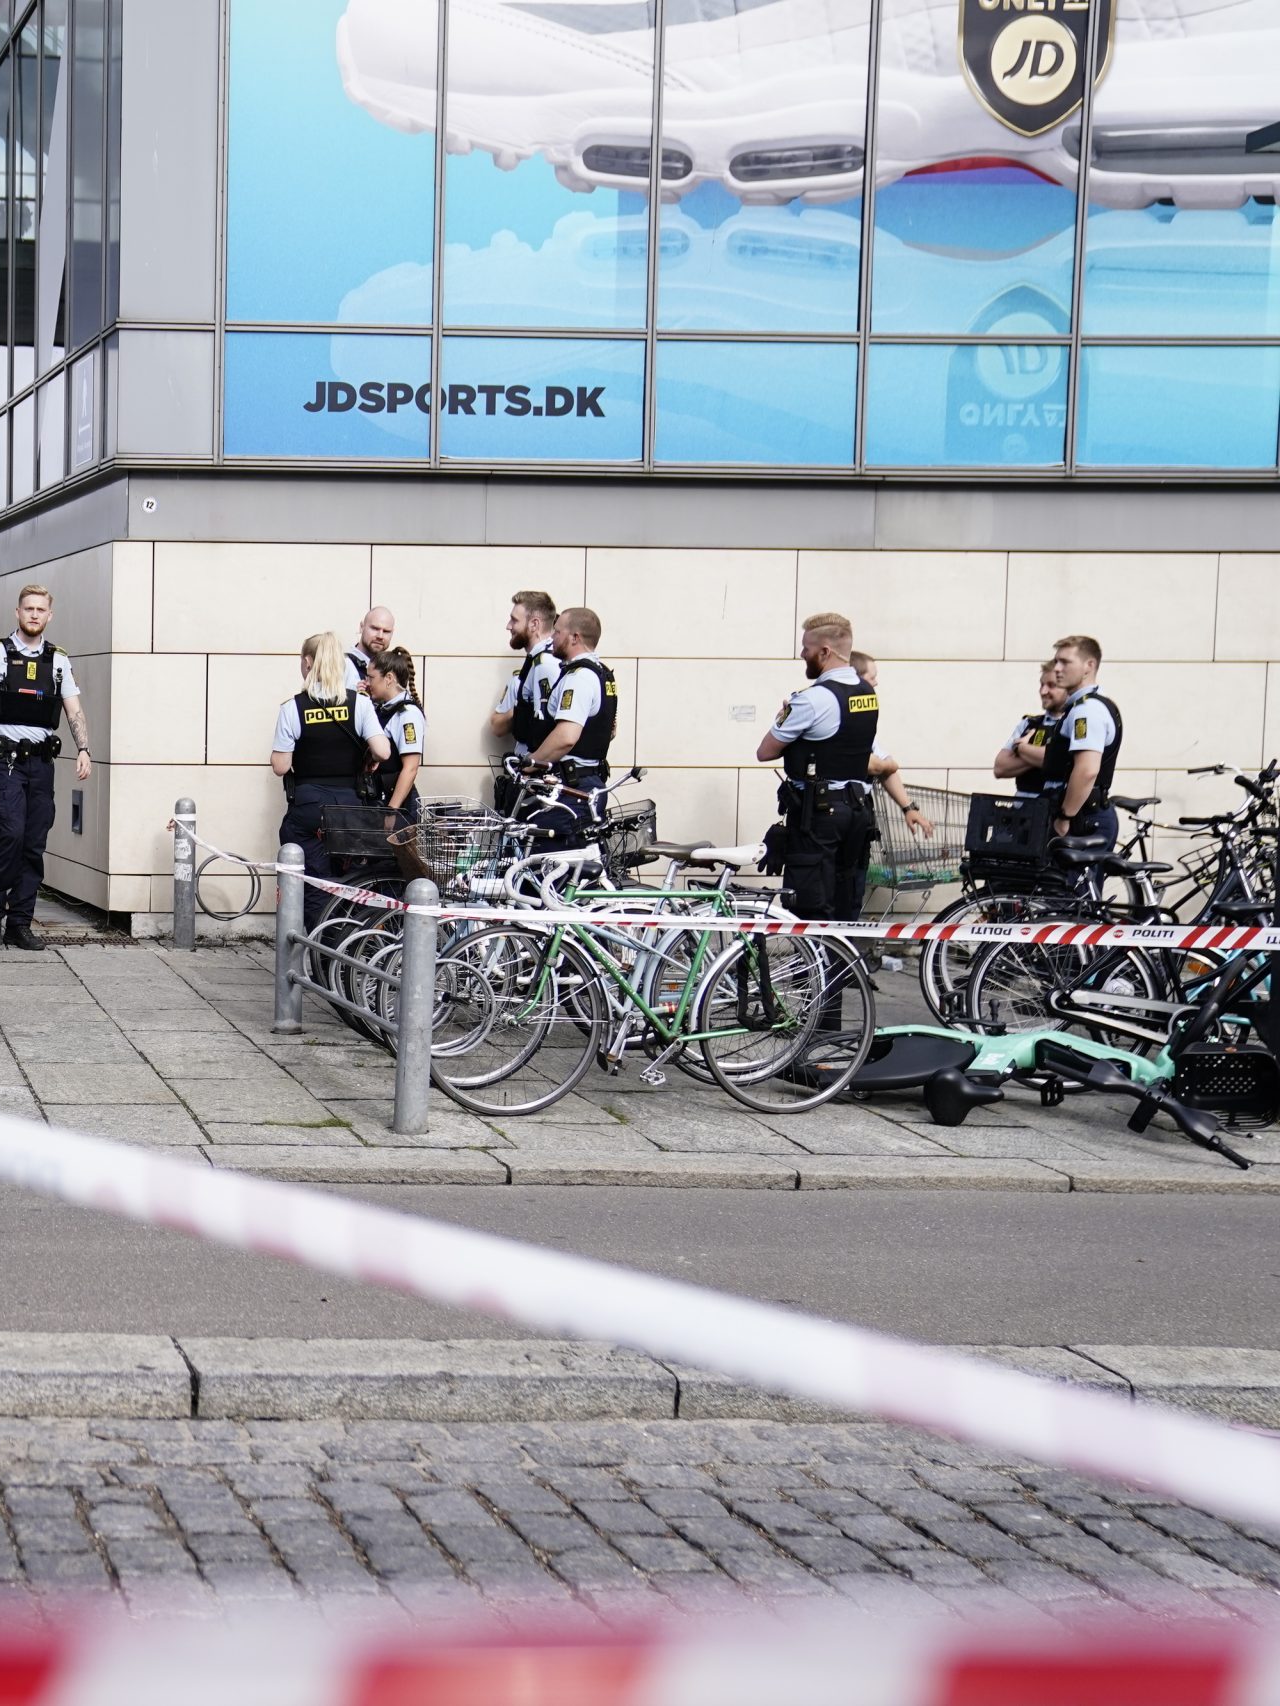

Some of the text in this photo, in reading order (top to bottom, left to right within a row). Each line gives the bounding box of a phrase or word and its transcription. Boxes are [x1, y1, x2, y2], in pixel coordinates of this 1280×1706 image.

[1002, 39, 1065, 81] JD
[303, 381, 607, 418] JDSPORTS.DK
[850, 697, 878, 710] POLITI
[306, 709, 348, 722] POLITI
[971, 926, 1013, 936] POLITI
[1132, 929, 1175, 938] POLITI
